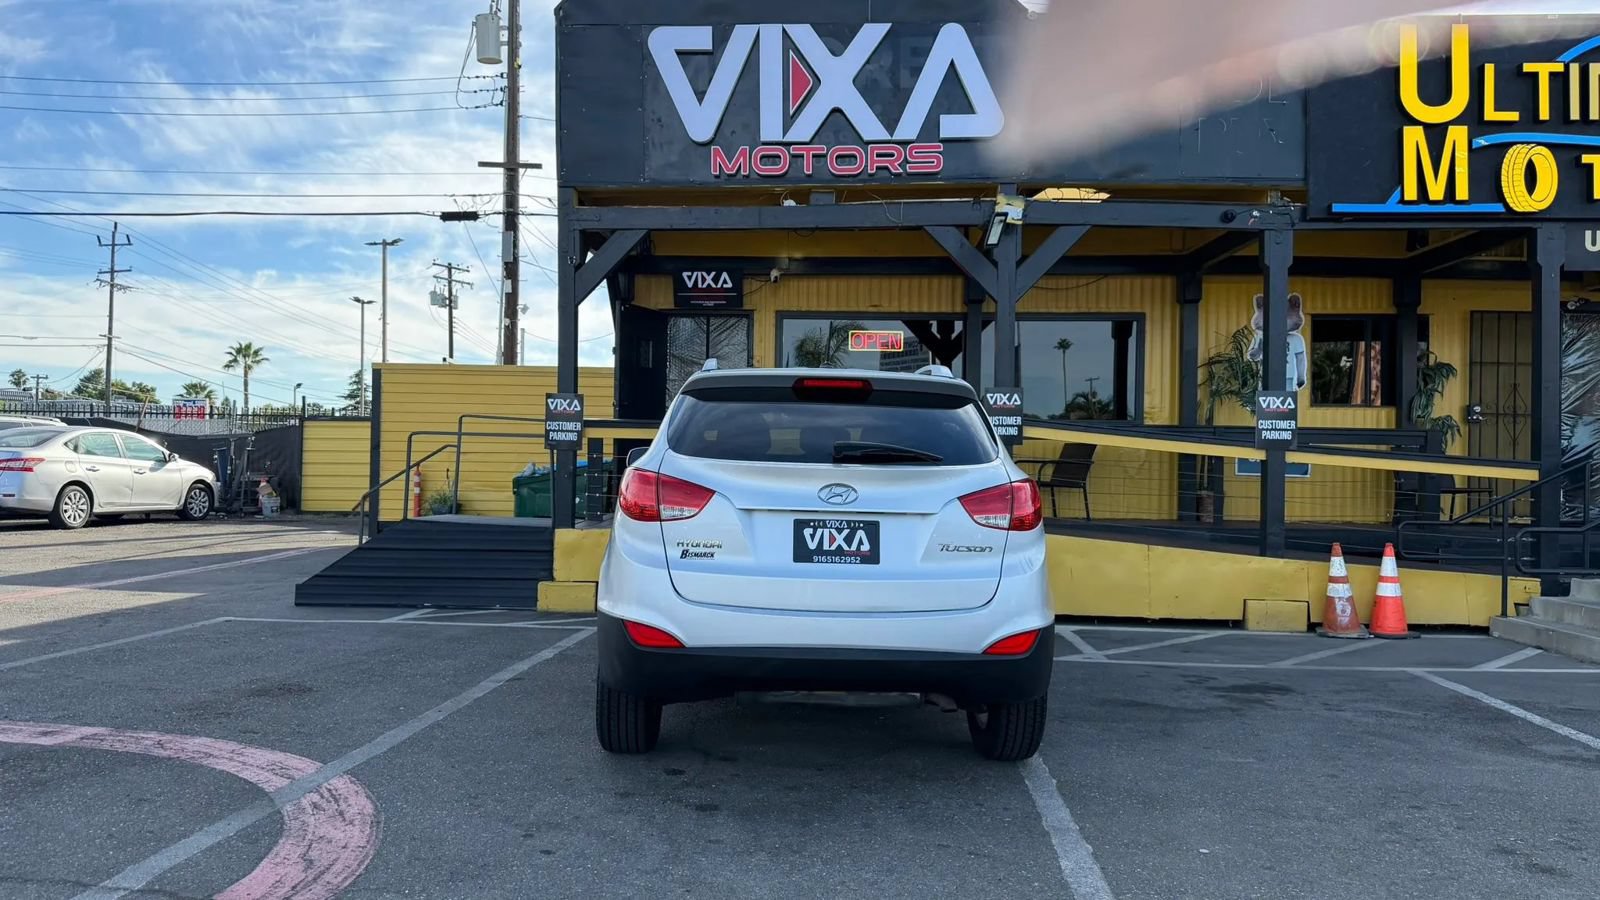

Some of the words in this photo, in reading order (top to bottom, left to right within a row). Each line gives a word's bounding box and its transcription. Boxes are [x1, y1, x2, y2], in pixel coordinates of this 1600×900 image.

[647, 22, 1004, 143] VIXA
[710, 143, 944, 176] MOTORS
[682, 271, 733, 288] VIXA
[851, 333, 901, 349] OPEN
[547, 398, 581, 410] VIXA
[986, 393, 1021, 405] VIXA
[1259, 396, 1295, 408] VIXA
[546, 421, 581, 431] CUSTOMER
[990, 416, 1021, 425] USTOMER
[1258, 420, 1296, 429] CUSTOMER
[994, 426, 1018, 435] ARKING
[1261, 431, 1292, 440] PARKING
[549, 432, 577, 441] PARKING
[825, 520, 848, 528] VIXA
[803, 528, 870, 551] VIXA
[812, 555, 861, 564] 9165162952
